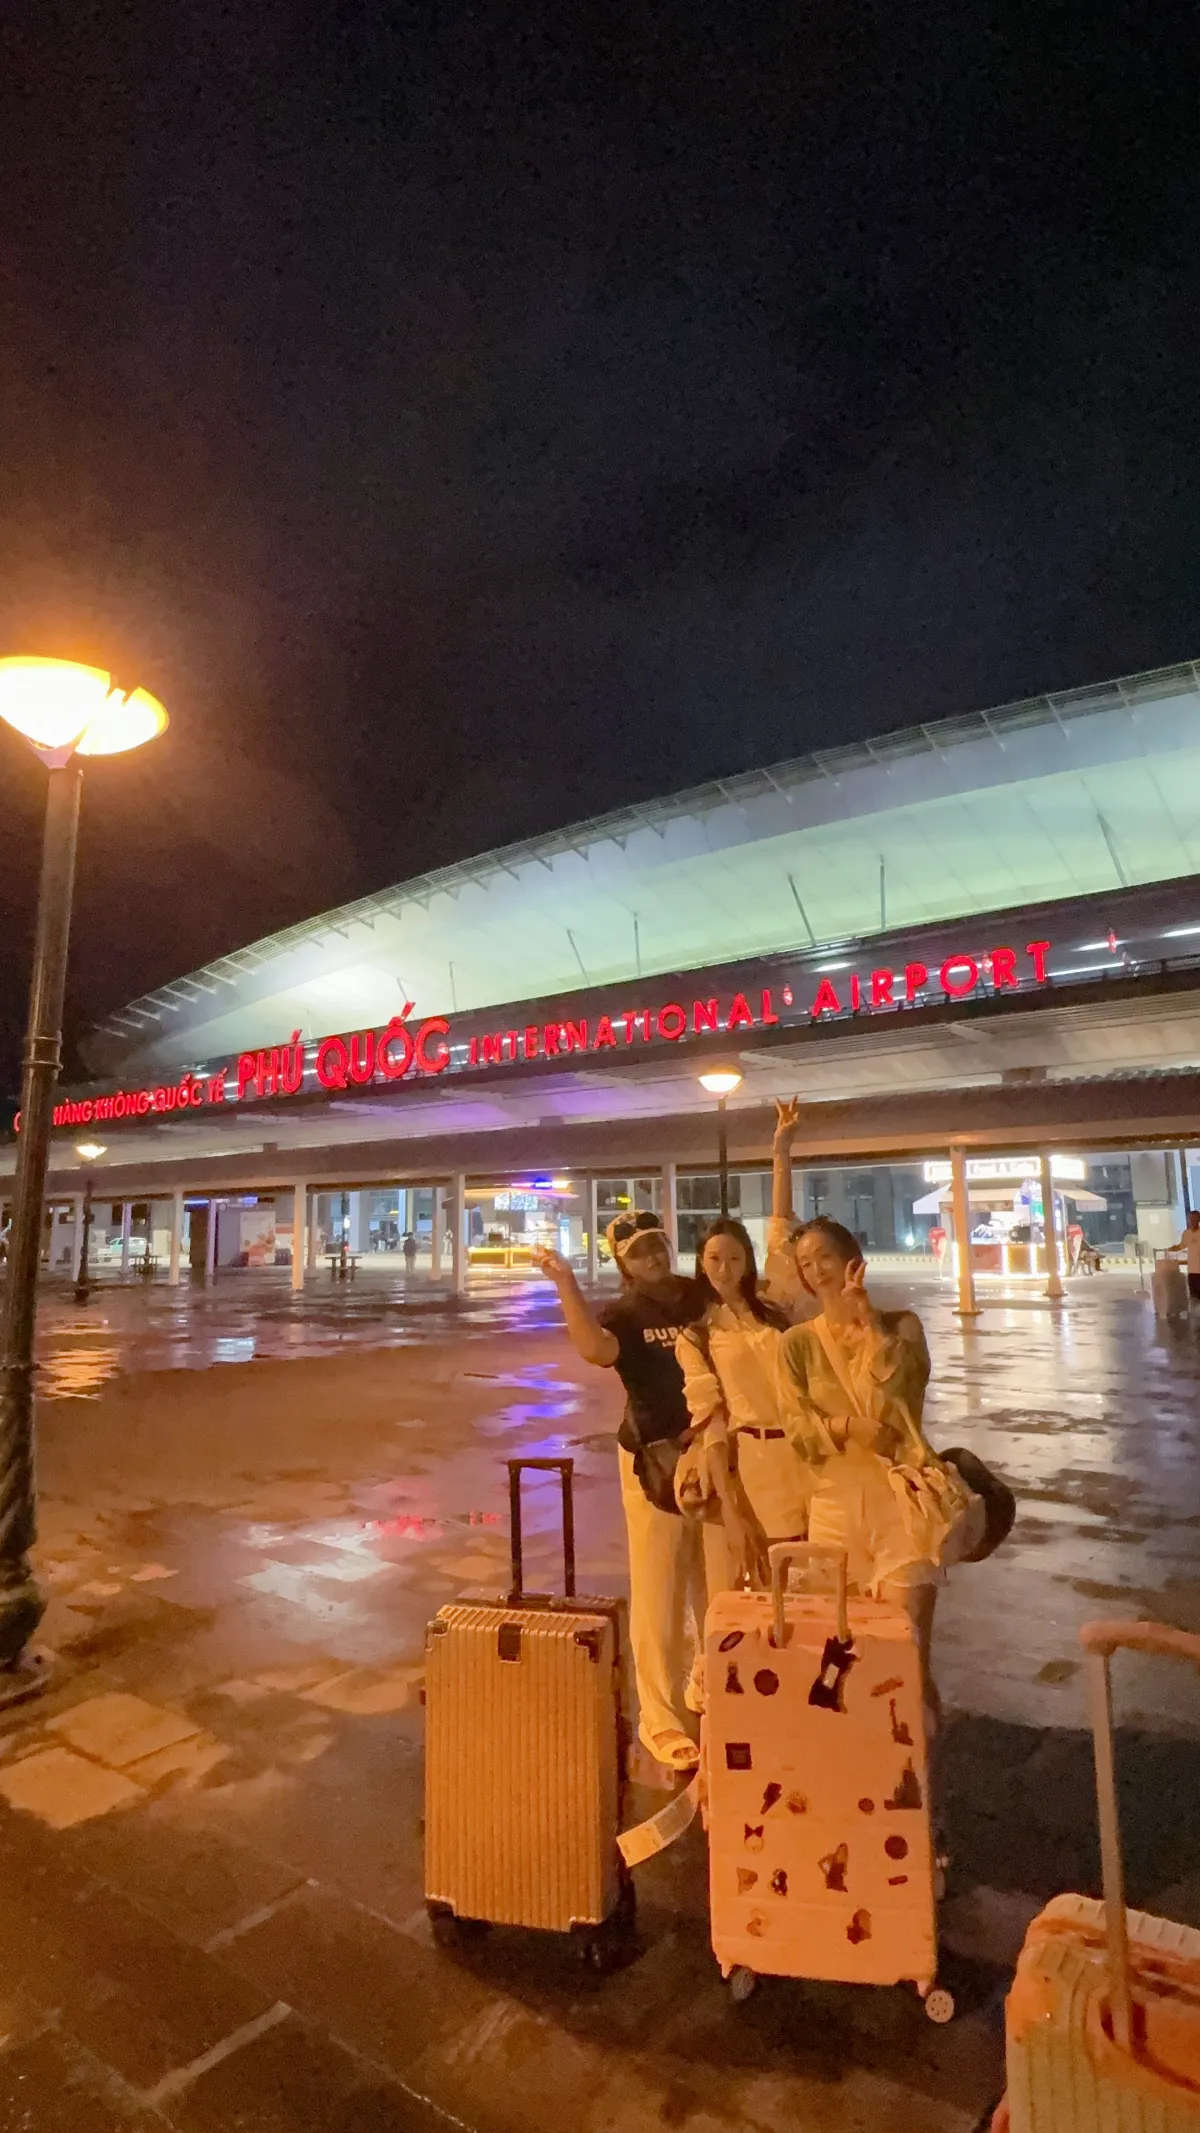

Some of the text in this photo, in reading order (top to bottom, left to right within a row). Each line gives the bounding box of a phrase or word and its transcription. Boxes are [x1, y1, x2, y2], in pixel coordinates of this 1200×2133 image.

[53, 1098, 93, 1126] HÀNG
[94, 1091, 149, 1120] KHÔNG
[238, 1029, 303, 1099] PHÚ
[316, 1001, 451, 1089] QUỐC
[469, 988, 779, 1064] INTERNATIONAL
[811, 941, 1051, 1018] AIRPORT
